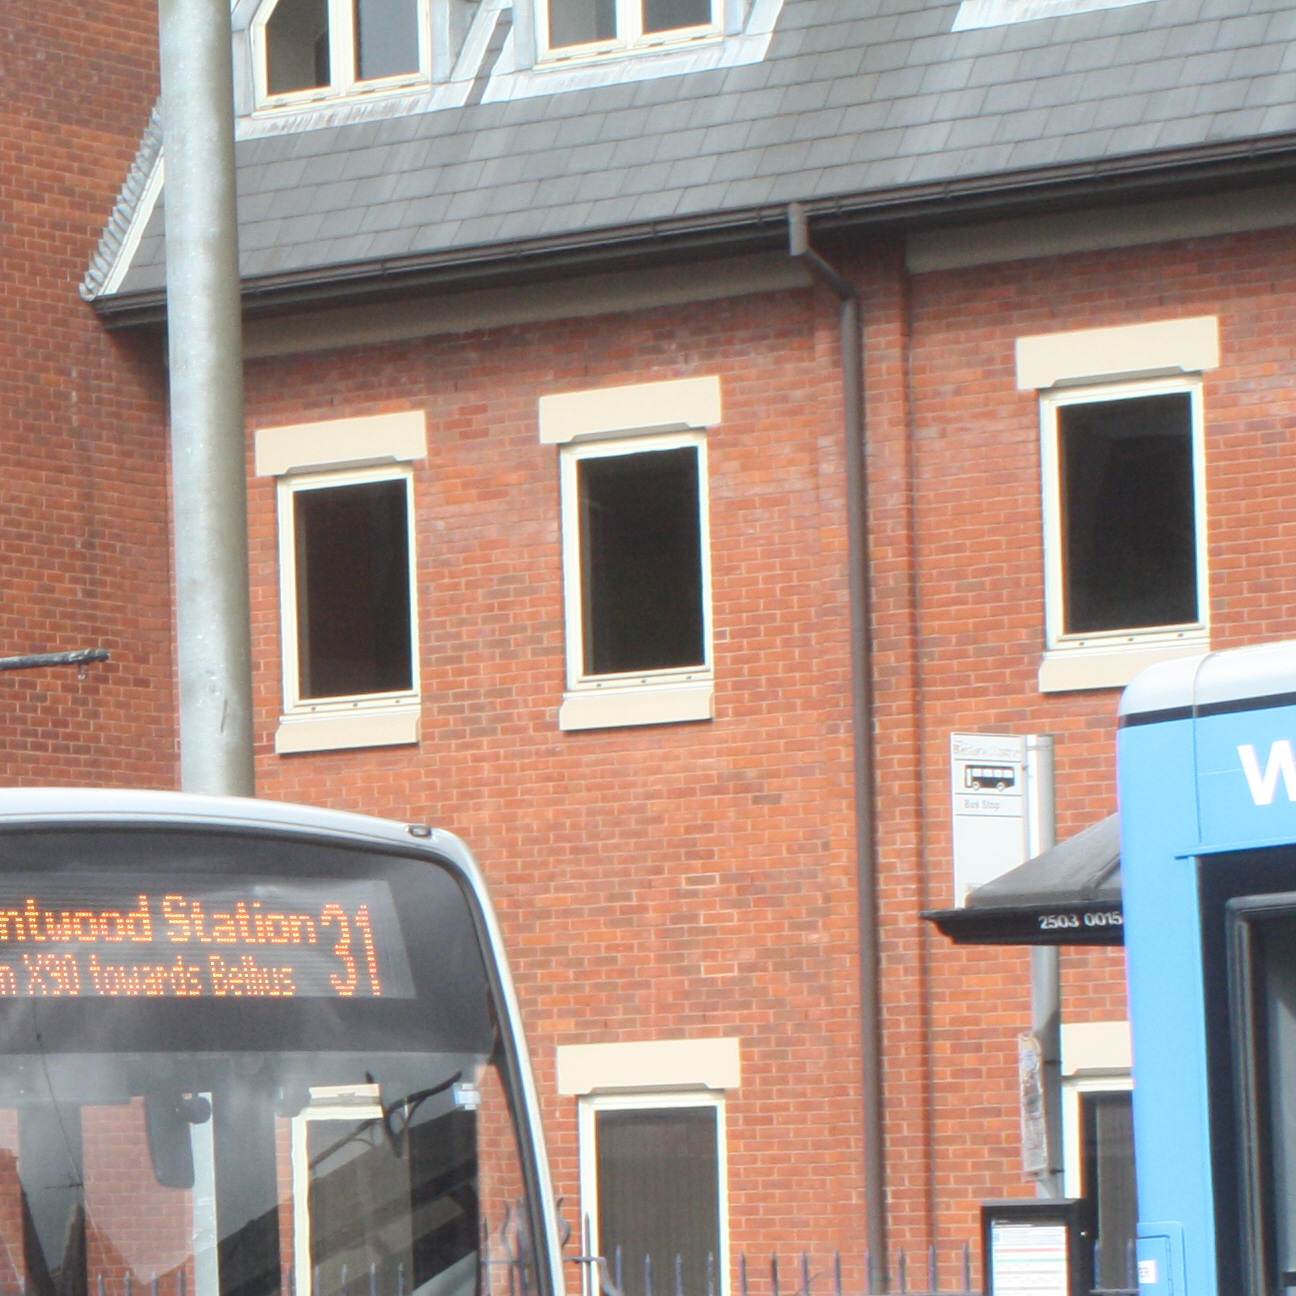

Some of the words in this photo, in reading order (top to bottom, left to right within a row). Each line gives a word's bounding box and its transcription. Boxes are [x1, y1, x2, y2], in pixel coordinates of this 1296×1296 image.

[964, 800, 980, 810] Bus
[982, 800, 1000, 812] Stop
[163, 894, 316, 943] Station
[1039, 913, 1079, 929] 2503
[322, 902, 381, 997] 31
[90, 954, 201, 997] towards
[209, 954, 296, 997] Belhus
